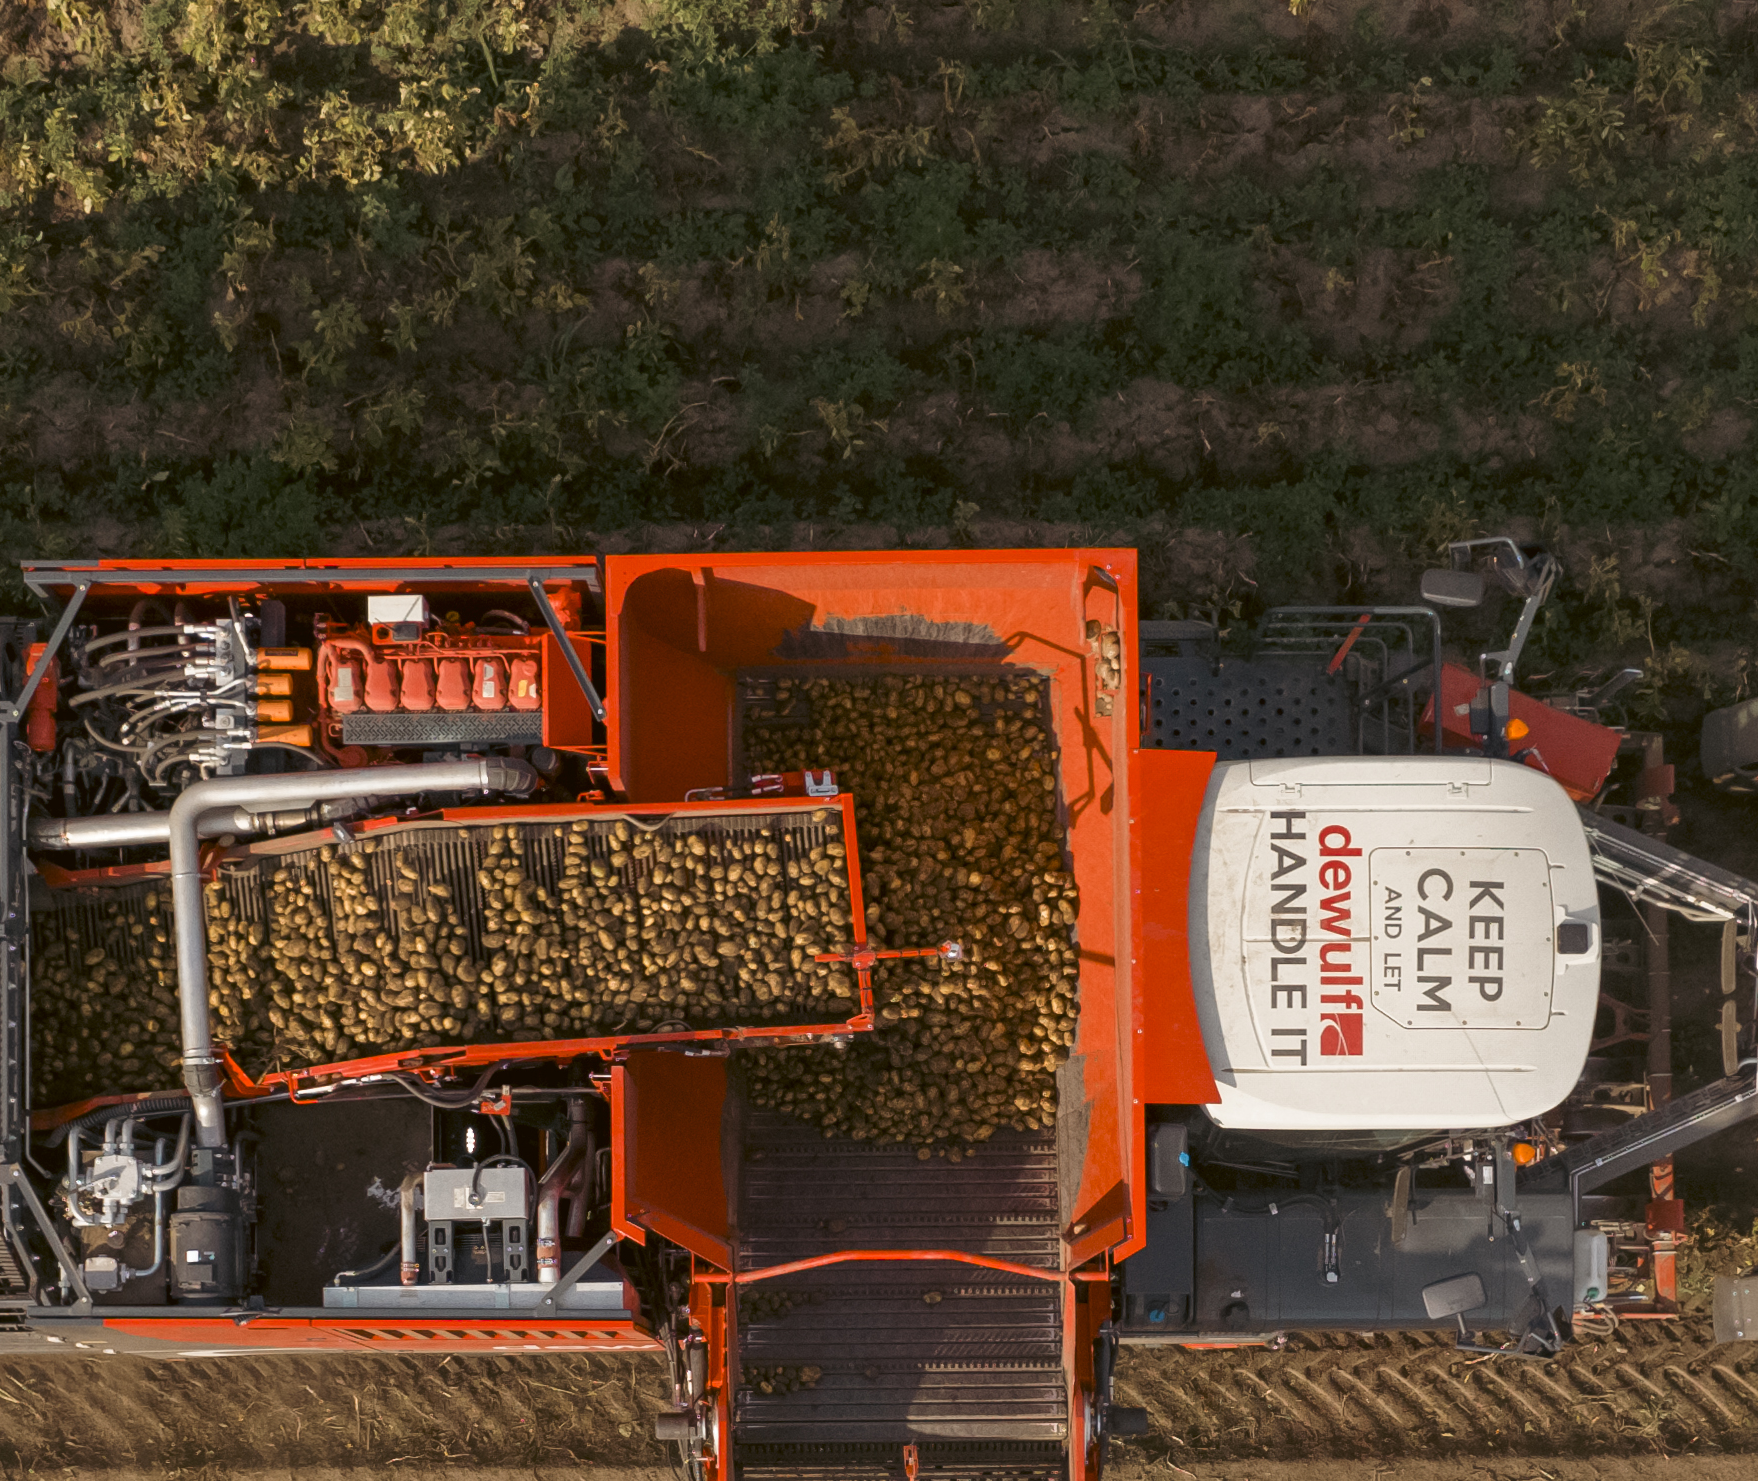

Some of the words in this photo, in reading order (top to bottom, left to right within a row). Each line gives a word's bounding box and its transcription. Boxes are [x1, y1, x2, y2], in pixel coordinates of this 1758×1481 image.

[1269, 811, 1308, 1009] HANDLE
[1318, 824, 1364, 1010] dewulf
[1384, 886, 1403, 939] AND
[1416, 868, 1454, 1012] CALM
[1468, 880, 1505, 1002] KEEP
[1383, 953, 1402, 992] LET
[1271, 1028, 1308, 1067] IT
